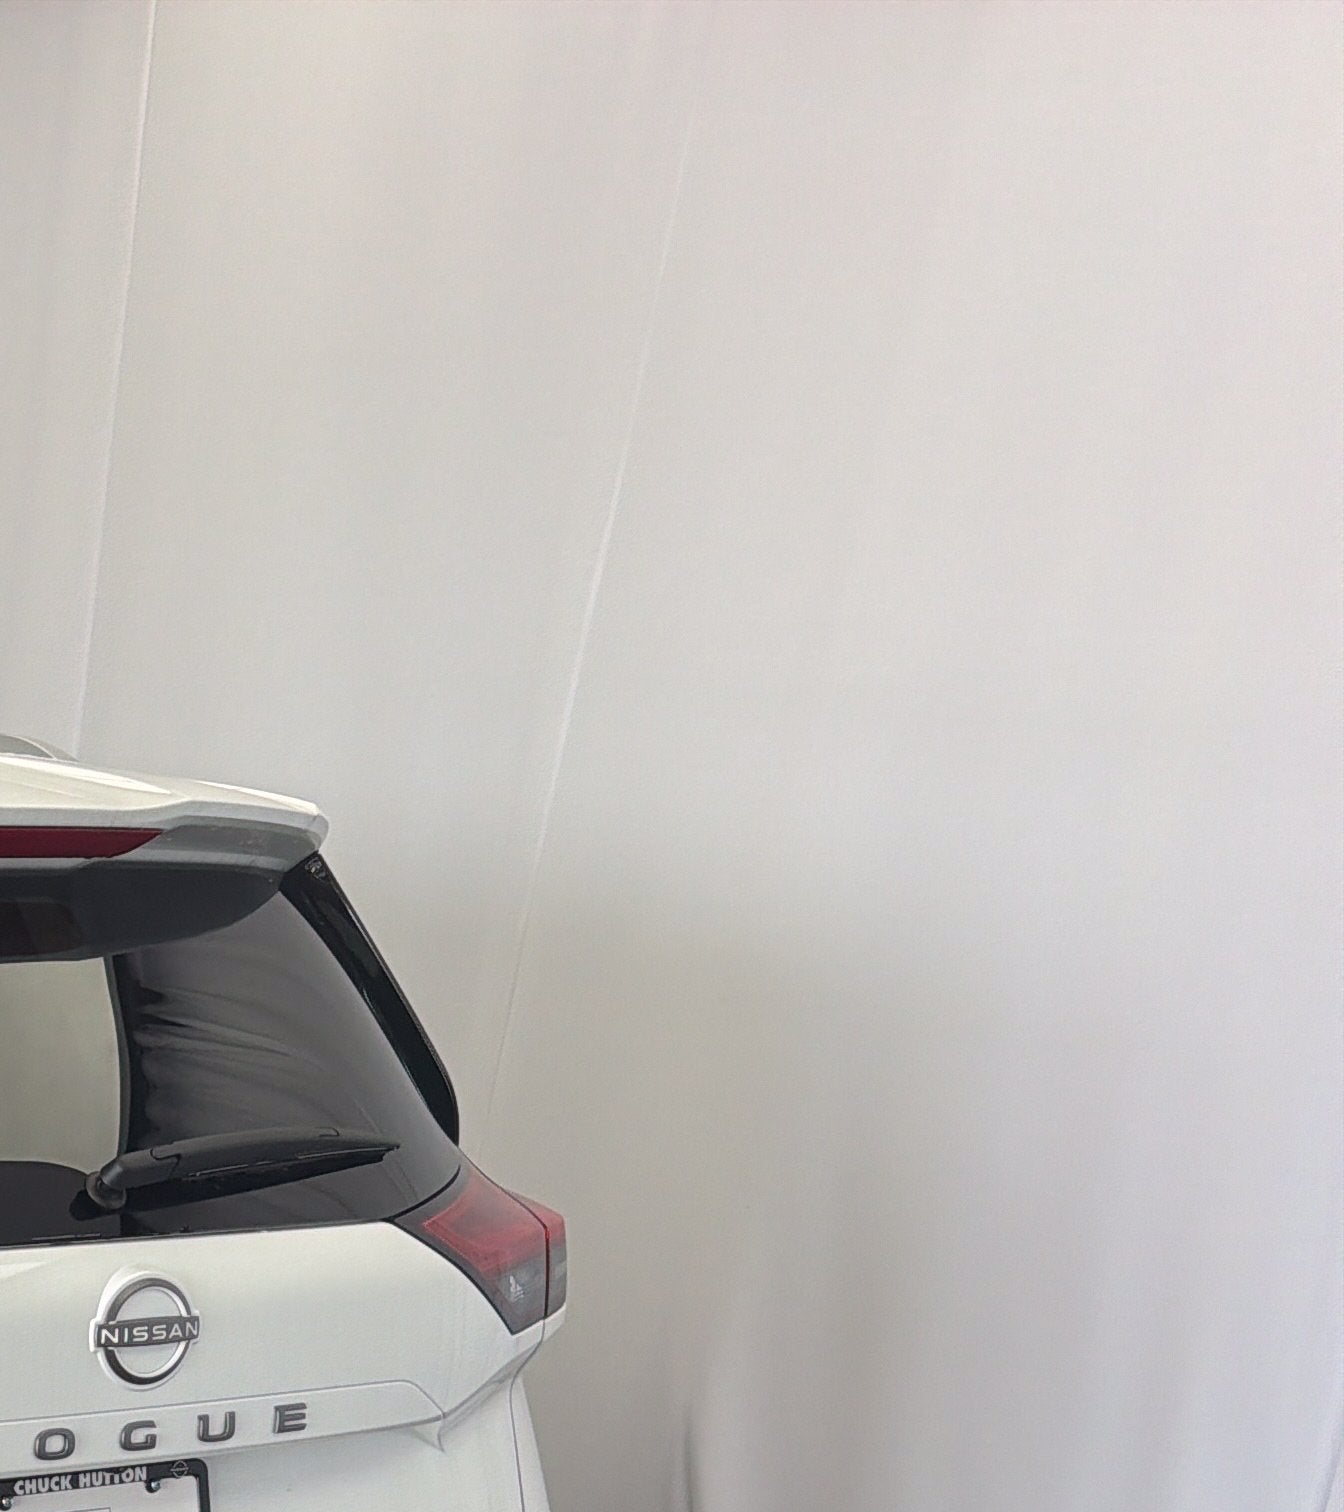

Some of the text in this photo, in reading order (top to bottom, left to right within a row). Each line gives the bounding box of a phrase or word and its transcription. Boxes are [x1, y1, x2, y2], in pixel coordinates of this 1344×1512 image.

[100, 1320, 198, 1345] NISSAN
[13, 1466, 147, 1496] CHUCK HUTTON
